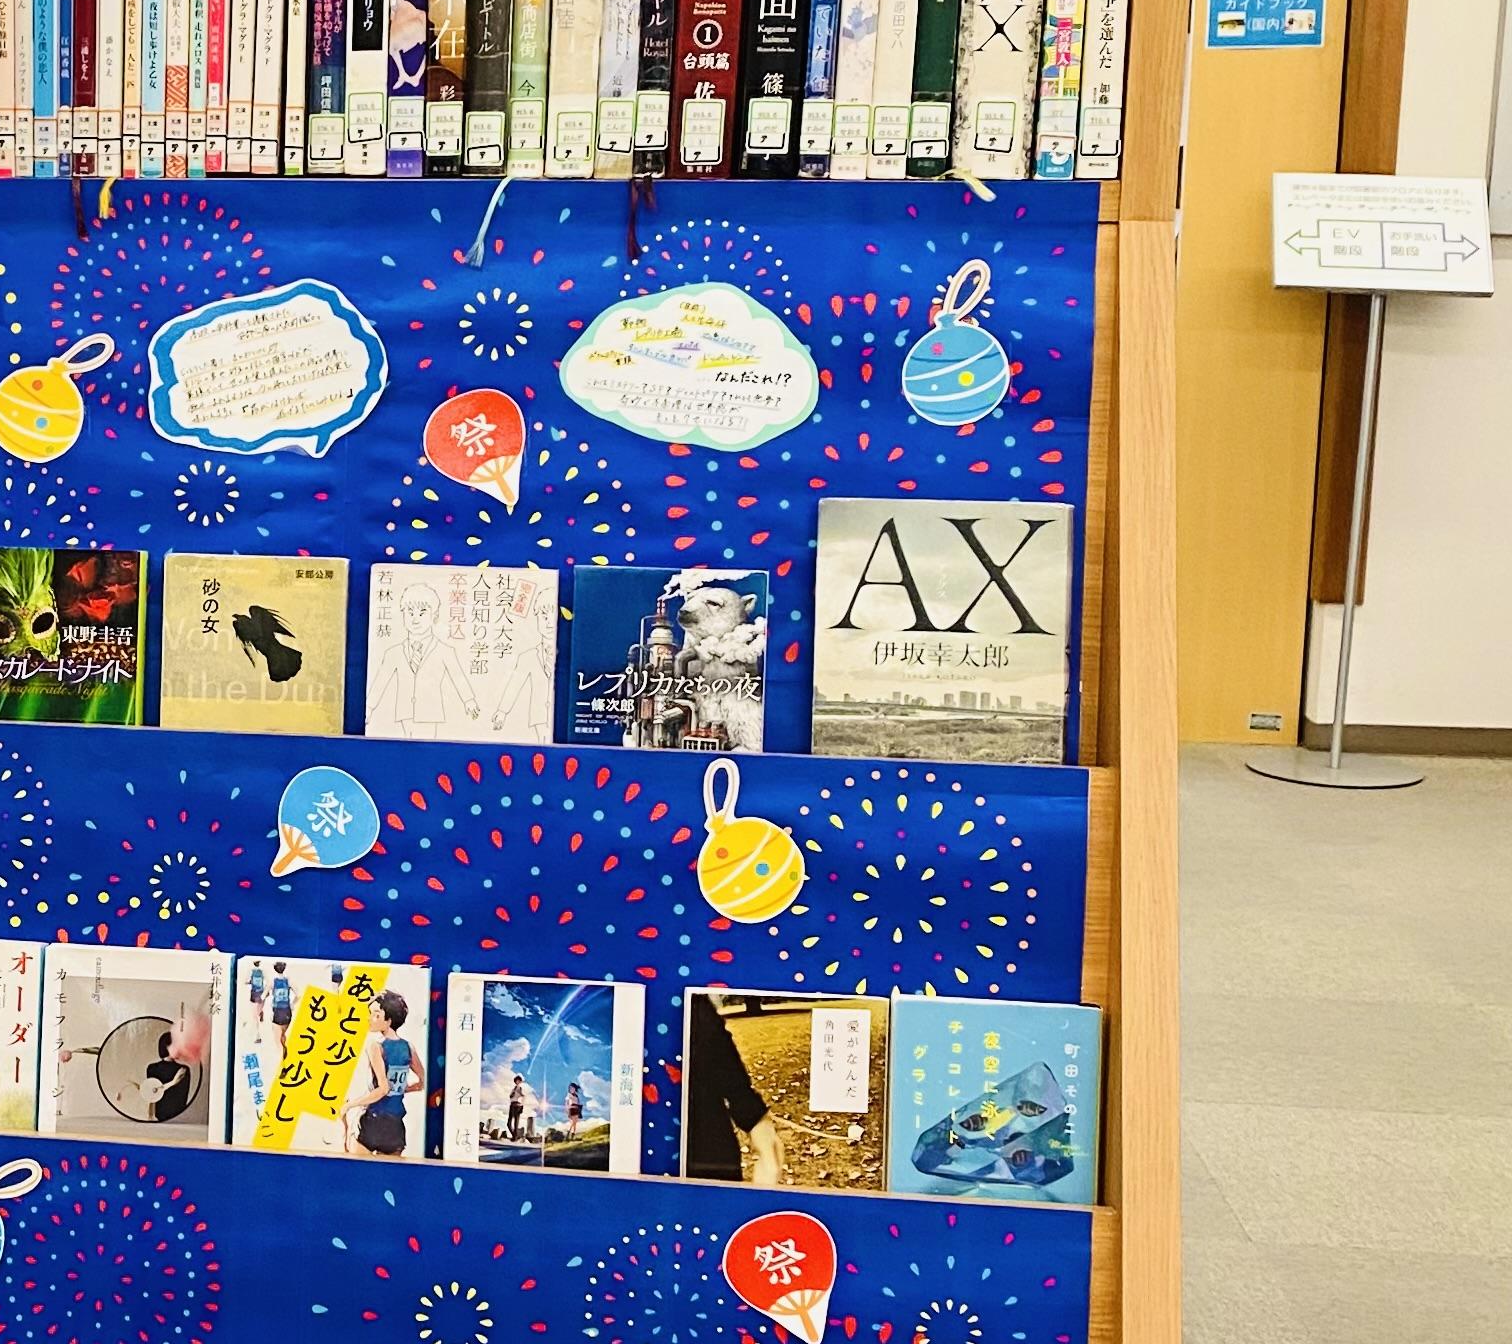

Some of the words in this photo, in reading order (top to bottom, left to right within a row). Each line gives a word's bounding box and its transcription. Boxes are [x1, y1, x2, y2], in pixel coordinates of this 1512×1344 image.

[148, 1, 159, 90] 夜は短し歩けよ乙女
[682, 51, 731, 72] 台頭篇
[1332, 227, 1361, 240] EV
[449, 412, 497, 458] 祭
[201, 577, 221, 635] 砂の女
[375, 570, 394, 638] 若林正恭
[447, 573, 468, 641] 卒業見込
[827, 516, 1058, 637] AX
[61, 624, 135, 647] 東野圭吾
[469, 572, 491, 676] 人見知り学部
[493, 573, 514, 659] 社会人大学
[576, 667, 763, 703] レプリカたちの夜
[872, 639, 1010, 670] 伊坂幸太郎
[305, 790, 353, 839] 祭
[8, 949, 35, 1086] オーダー
[317, 972, 377, 1116] あと少し、
[822, 1017, 836, 1073] 角田光代
[273, 994, 328, 1124] もう少し
[455, 1010, 476, 1154] 君の名は。
[617, 1062, 635, 1107] 新海誠
[844, 1018, 861, 1099] 愛がなんだ
[911, 1043, 930, 1131] グラミー
[947, 1020, 964, 1146] チョコレート
[1062, 1041, 1082, 1137] 町田そのこ
[753, 1237, 807, 1286] 祭
